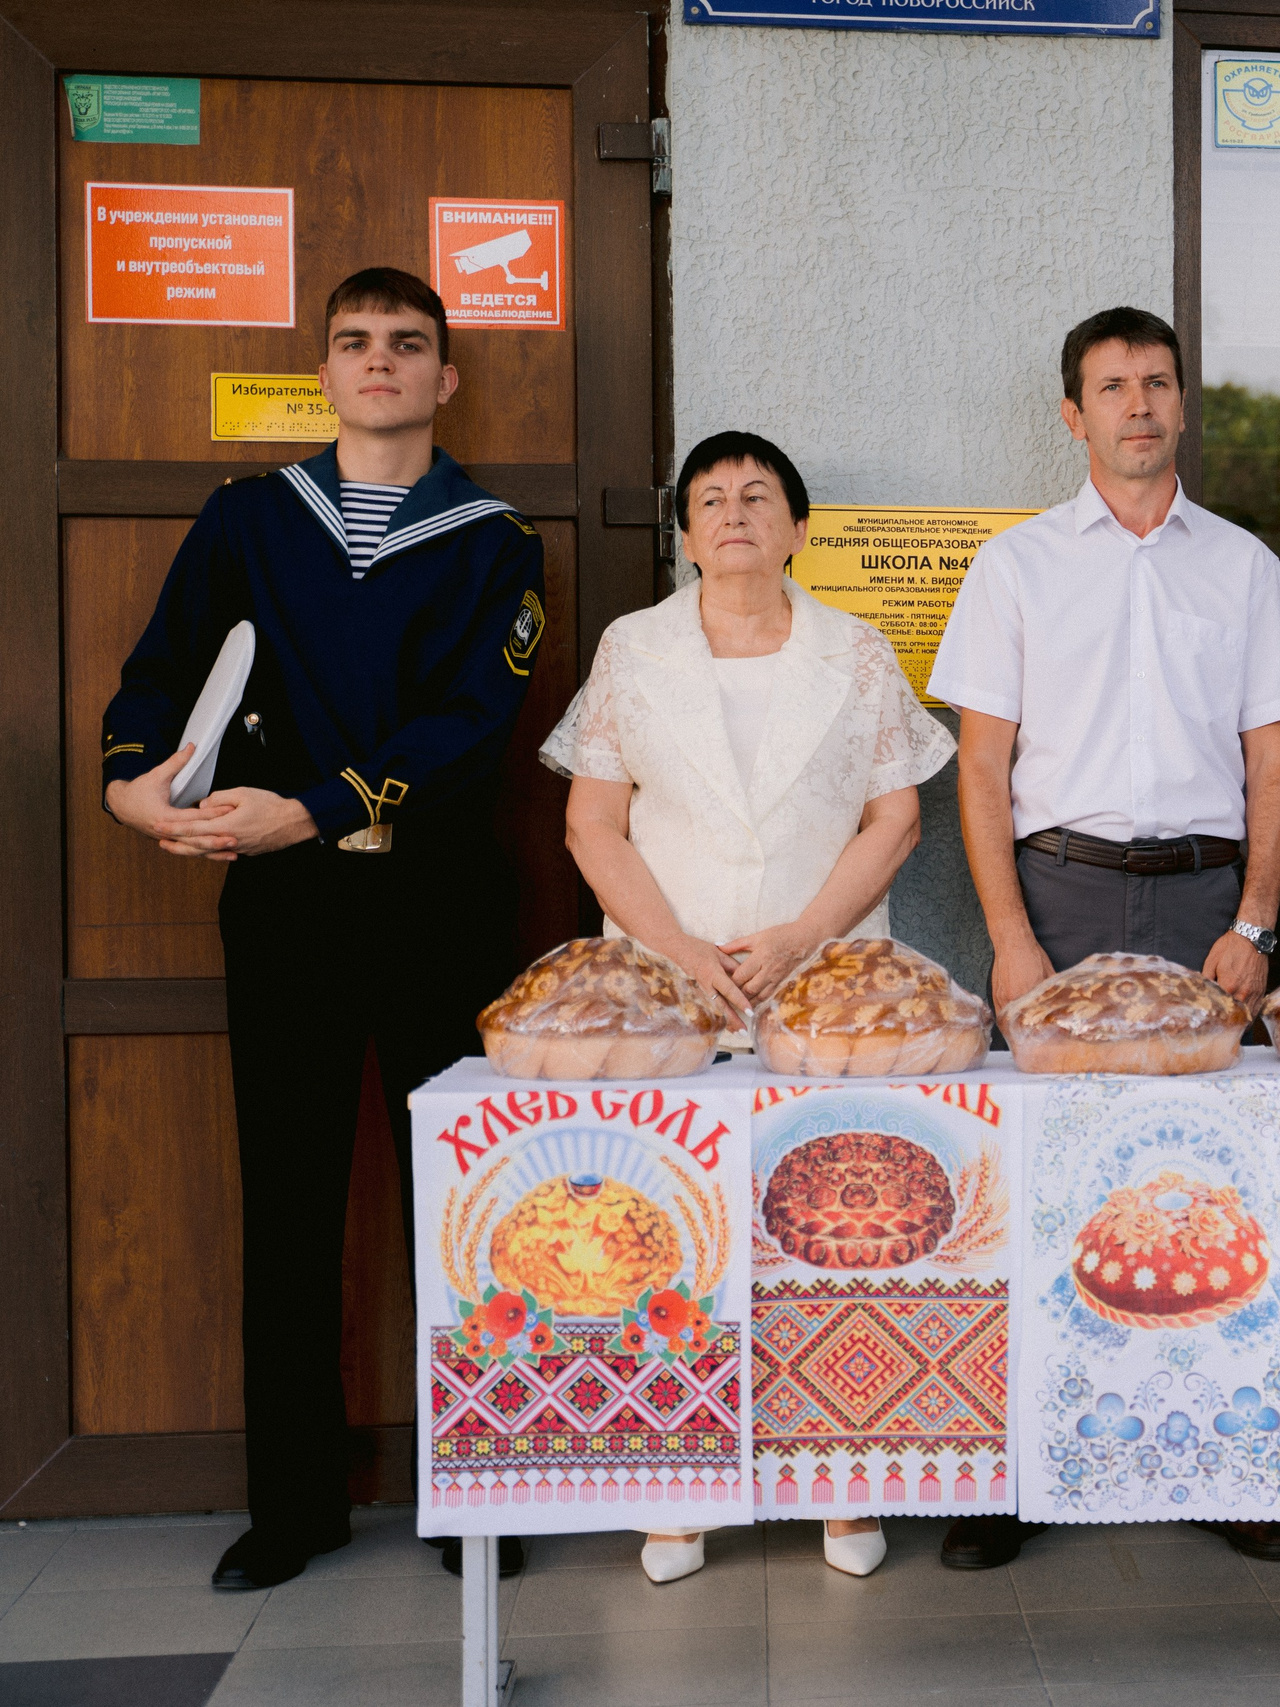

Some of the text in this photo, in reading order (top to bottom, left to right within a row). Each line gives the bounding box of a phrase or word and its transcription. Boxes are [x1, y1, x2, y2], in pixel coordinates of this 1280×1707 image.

[97, 206, 283, 227] В учреждении установлен
[442, 211, 553, 226] ВНИМАНИЕ!!!
[149, 235, 232, 251] пропускной
[116, 260, 265, 276] и внутреобъектовый
[166, 286, 216, 300] режим
[460, 293, 537, 308] ВЕДЕТСЯ
[445, 309, 552, 319] ВИДЕОНАБЛЮДЕНИЕ
[231, 383, 324, 398] Избирательн
[286, 403, 303, 415] №
[857, 518, 978, 527] МУНИЦИПАЛЬНОЕ АВТОНОМНОЕ
[843, 526, 993, 535] ОБЩЕОБРАЗОВАТЕЛЬНОЕ УЧРЕЖДЕНИЕ
[810, 537, 988, 549] СРЕДНЯЯ ОБЩЕОБРАЗОВАТ
[861, 555, 975, 571] ШКОЛА №4
[869, 576, 904, 584] ИМЕНИ
[907, 576, 917, 585] М.
[920, 577, 928, 585] К.
[917, 600, 955, 608] РАБОТЫ
[436, 1089, 732, 1177] ХЛЕБ СОЛЬ
